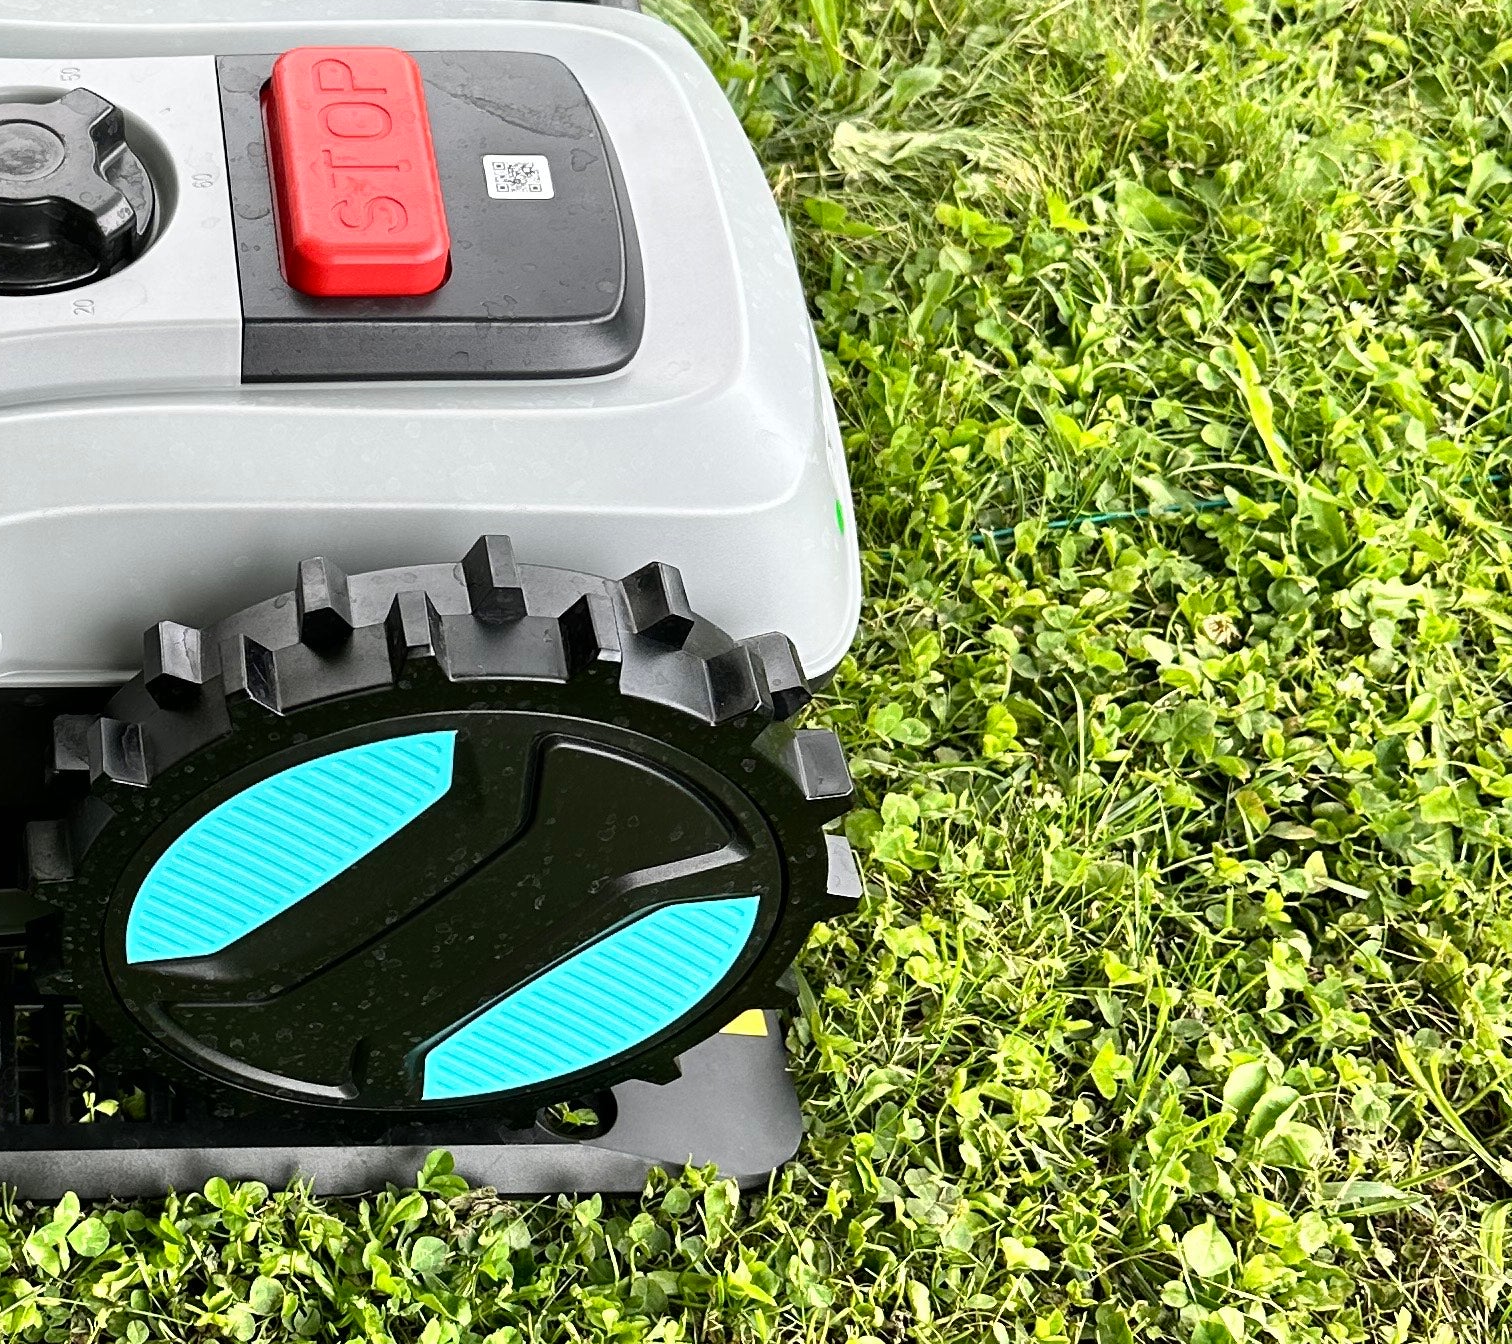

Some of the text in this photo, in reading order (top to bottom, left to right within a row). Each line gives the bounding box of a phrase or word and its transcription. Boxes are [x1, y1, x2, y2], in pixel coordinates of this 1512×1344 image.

[60, 67, 81, 82] 50
[310, 58, 409, 233] STOP
[191, 173, 213, 188] 60
[73, 299, 95, 316] 20
